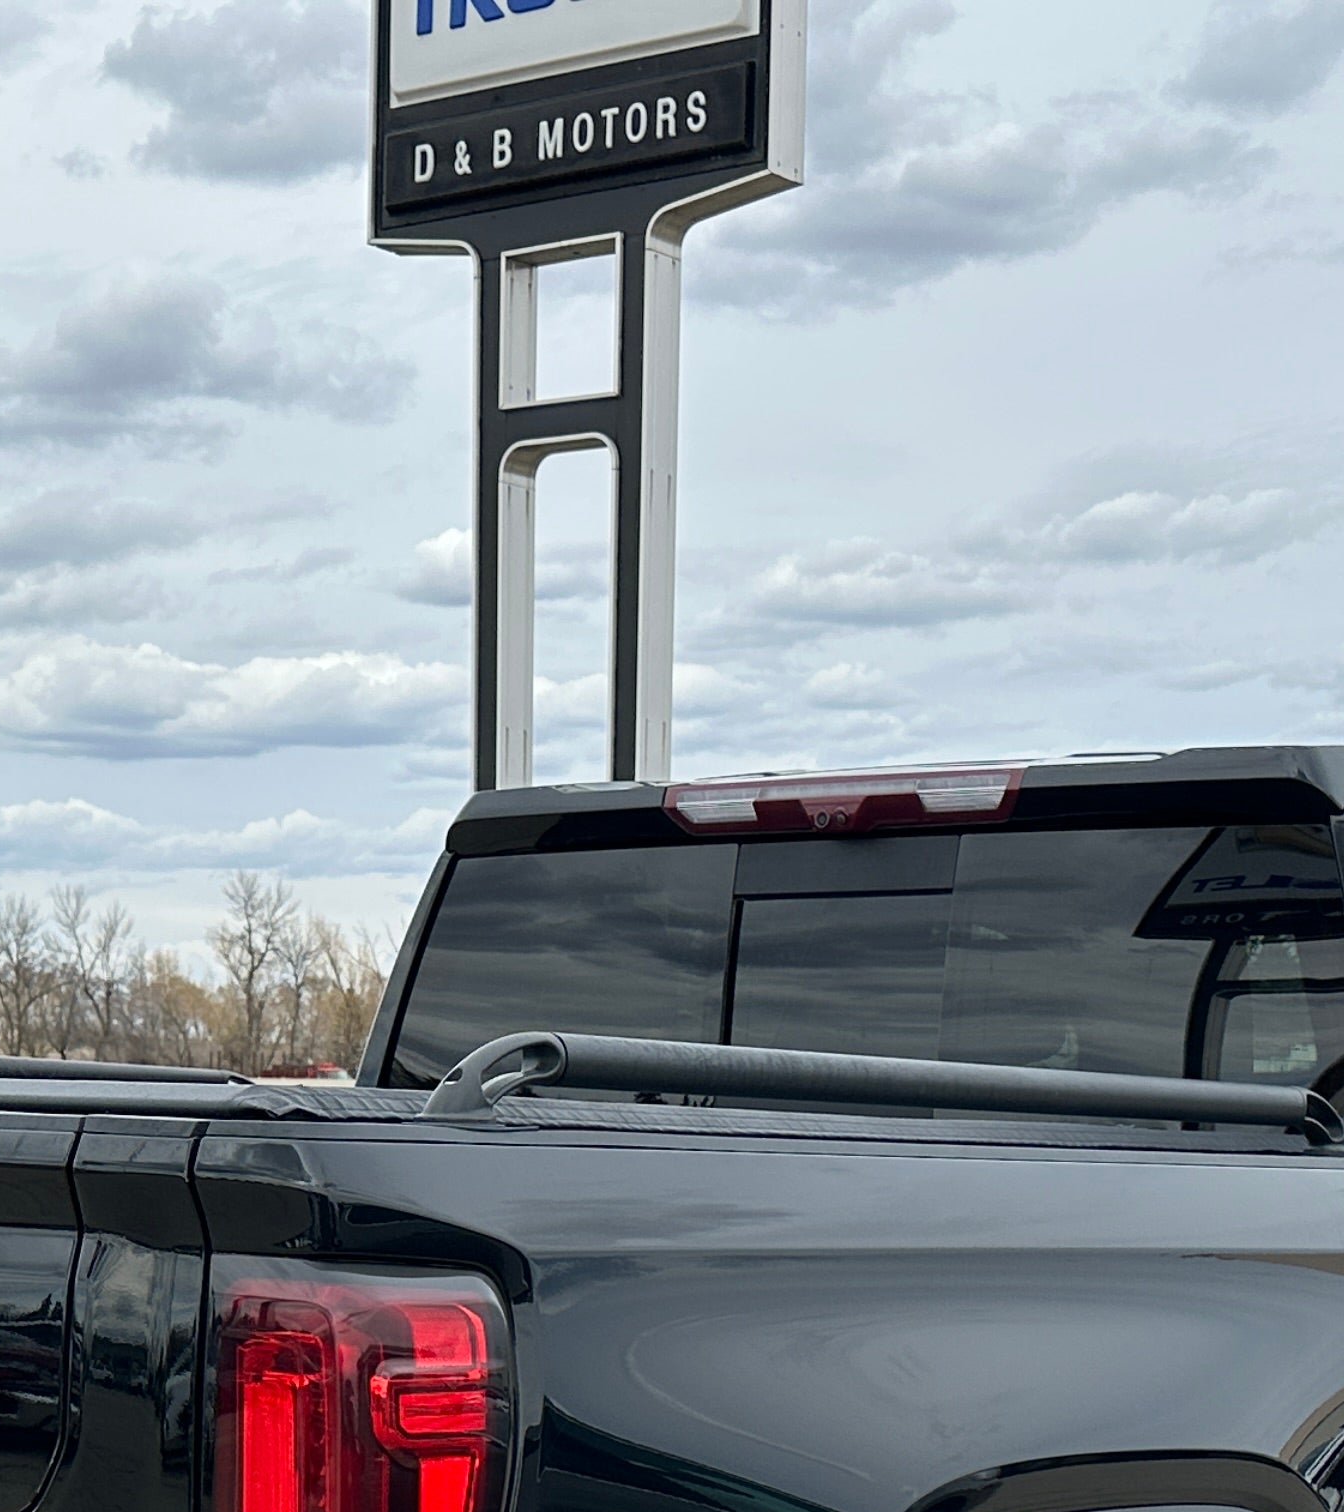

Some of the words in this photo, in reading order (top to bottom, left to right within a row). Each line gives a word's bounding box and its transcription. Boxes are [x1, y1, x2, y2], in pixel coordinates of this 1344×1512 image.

[413, 142, 435, 184] D
[454, 140, 473, 176] &
[492, 128, 513, 169] B
[538, 90, 708, 161] MOTORS
